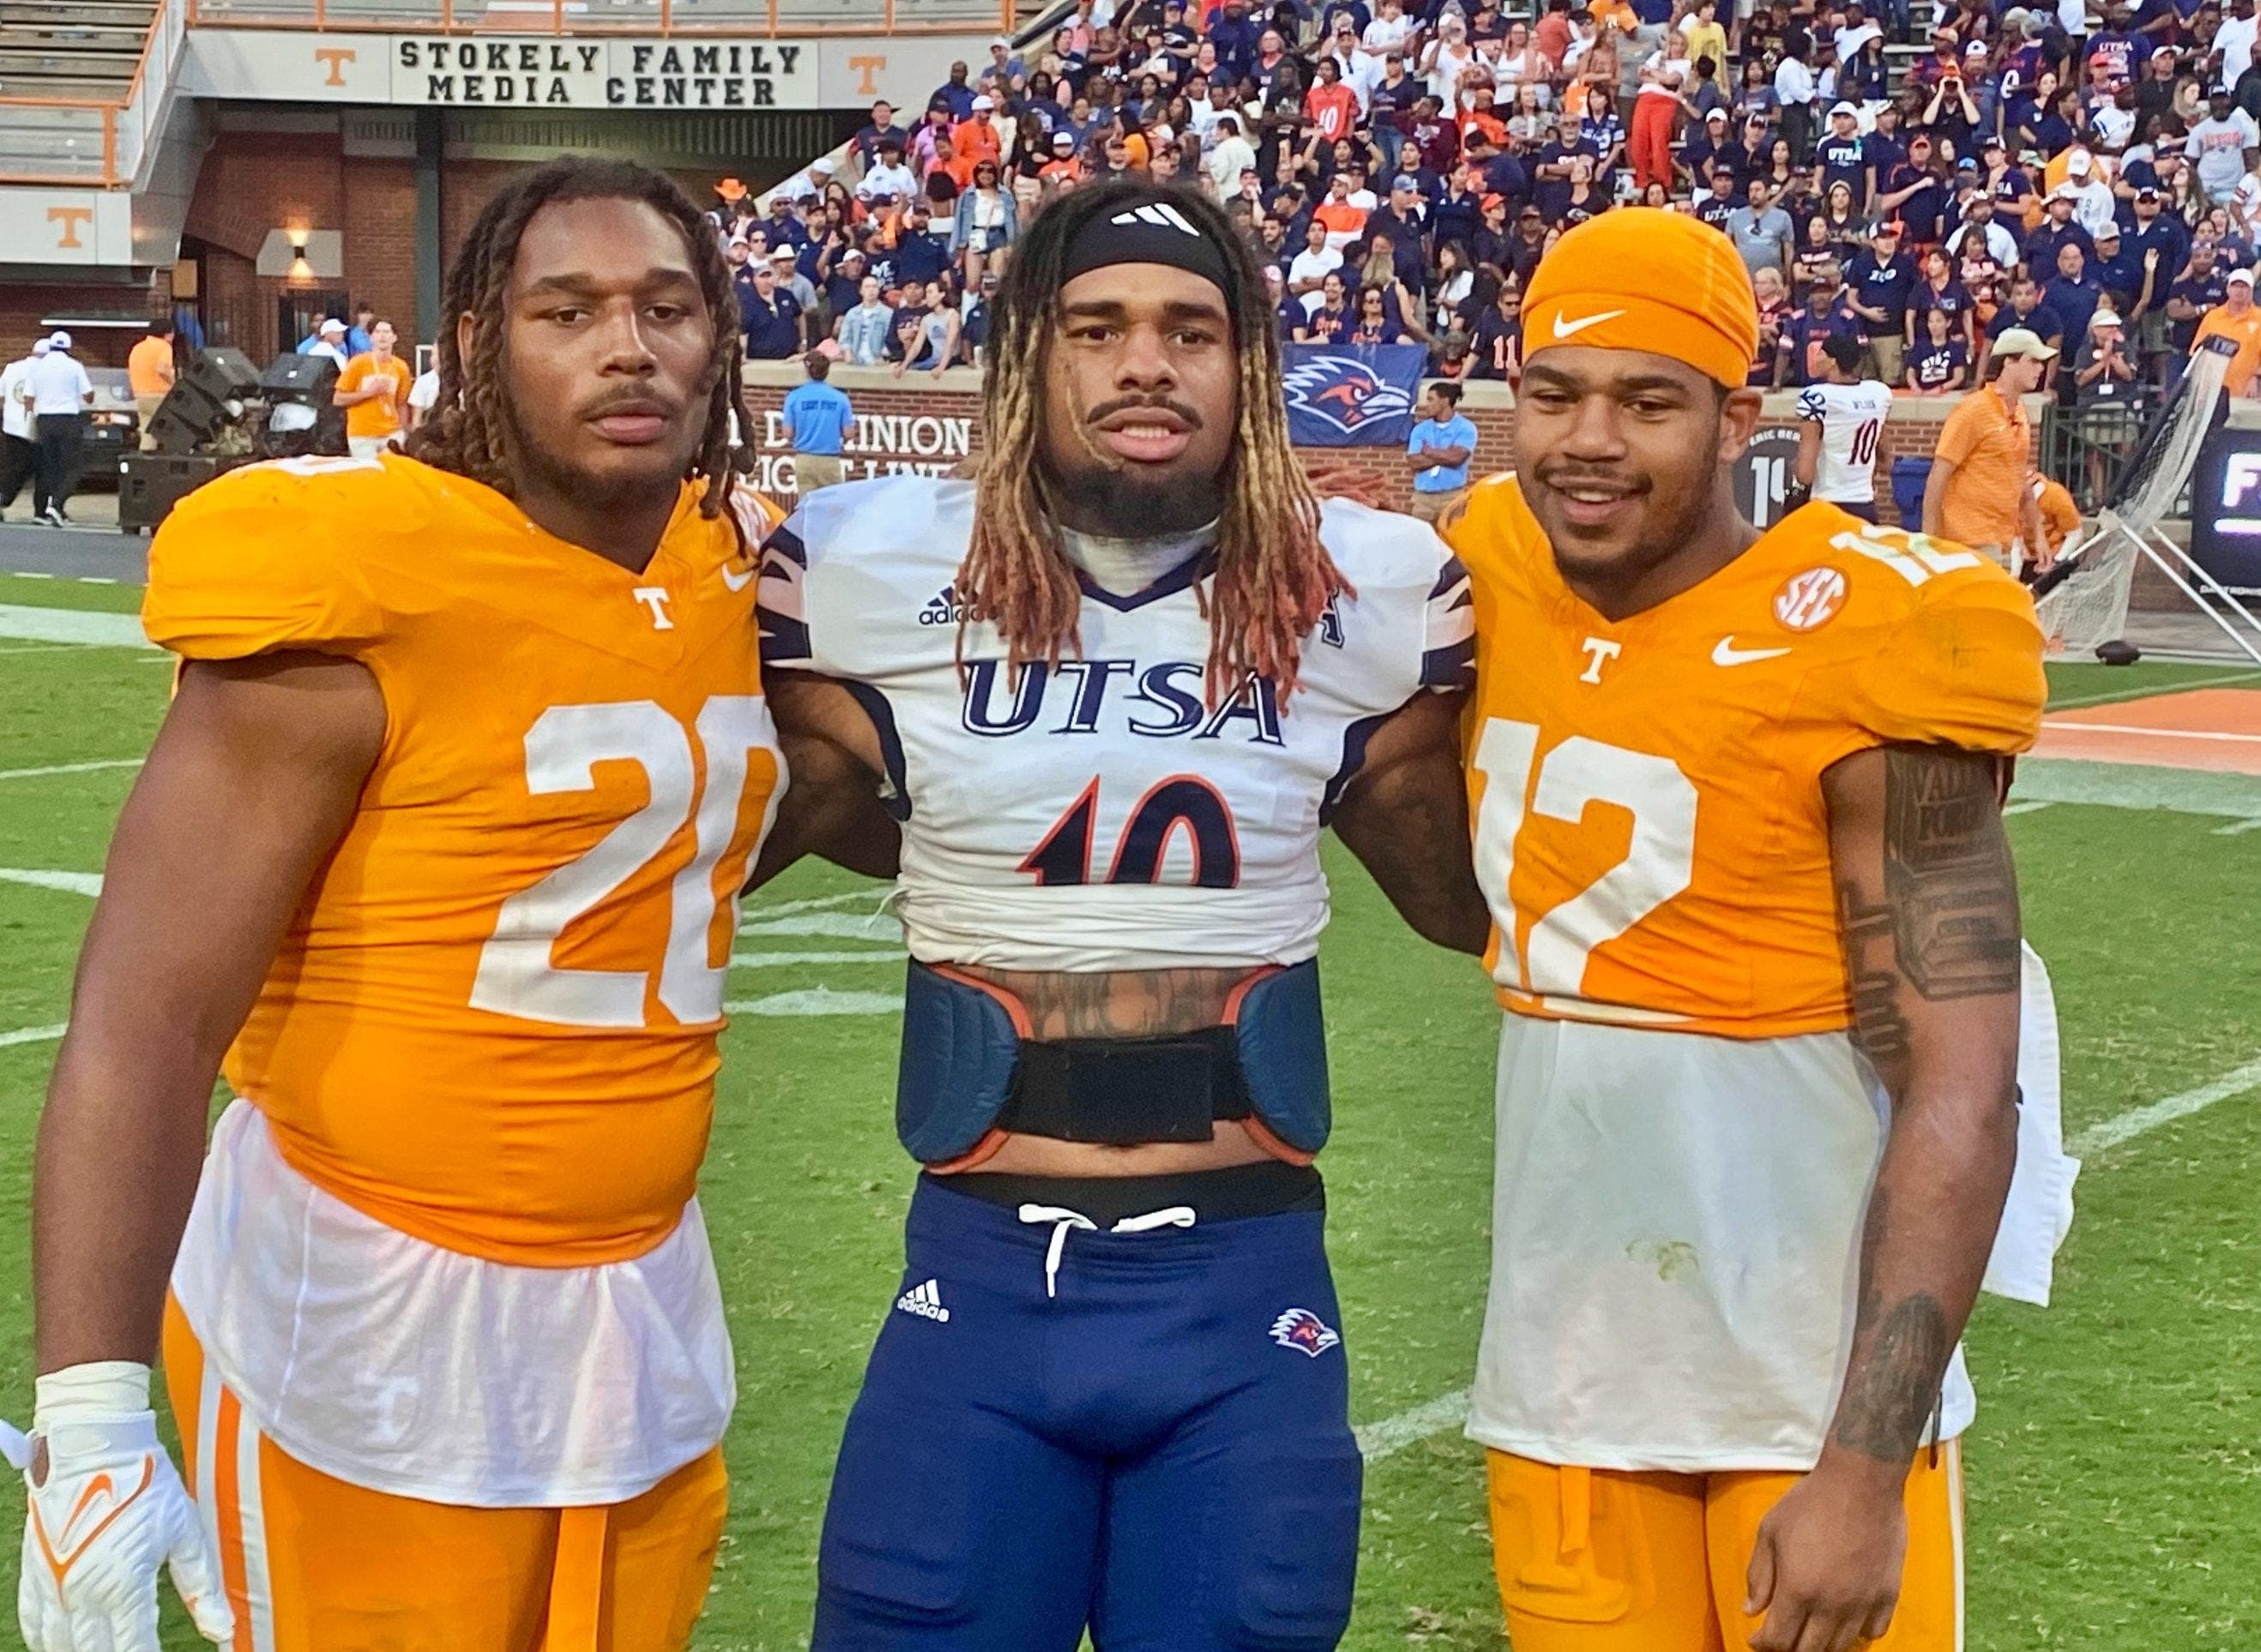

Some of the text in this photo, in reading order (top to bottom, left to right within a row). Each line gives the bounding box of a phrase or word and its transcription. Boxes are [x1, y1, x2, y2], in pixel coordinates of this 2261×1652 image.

[315, 48, 357, 87] T
[401, 42, 799, 73] STOKELY FAMILY
[848, 55, 887, 95] T
[428, 75, 775, 106] MEDIA CENTER
[47, 208, 93, 248] T
[1848, 417, 1879, 466] 10
[633, 587, 673, 630] T
[1776, 566, 1845, 630] SEC
[1579, 636, 1622, 684] T
[961, 659, 1287, 747] UTSA
[468, 695, 790, 1028] 20
[1473, 716, 1699, 998] 12
